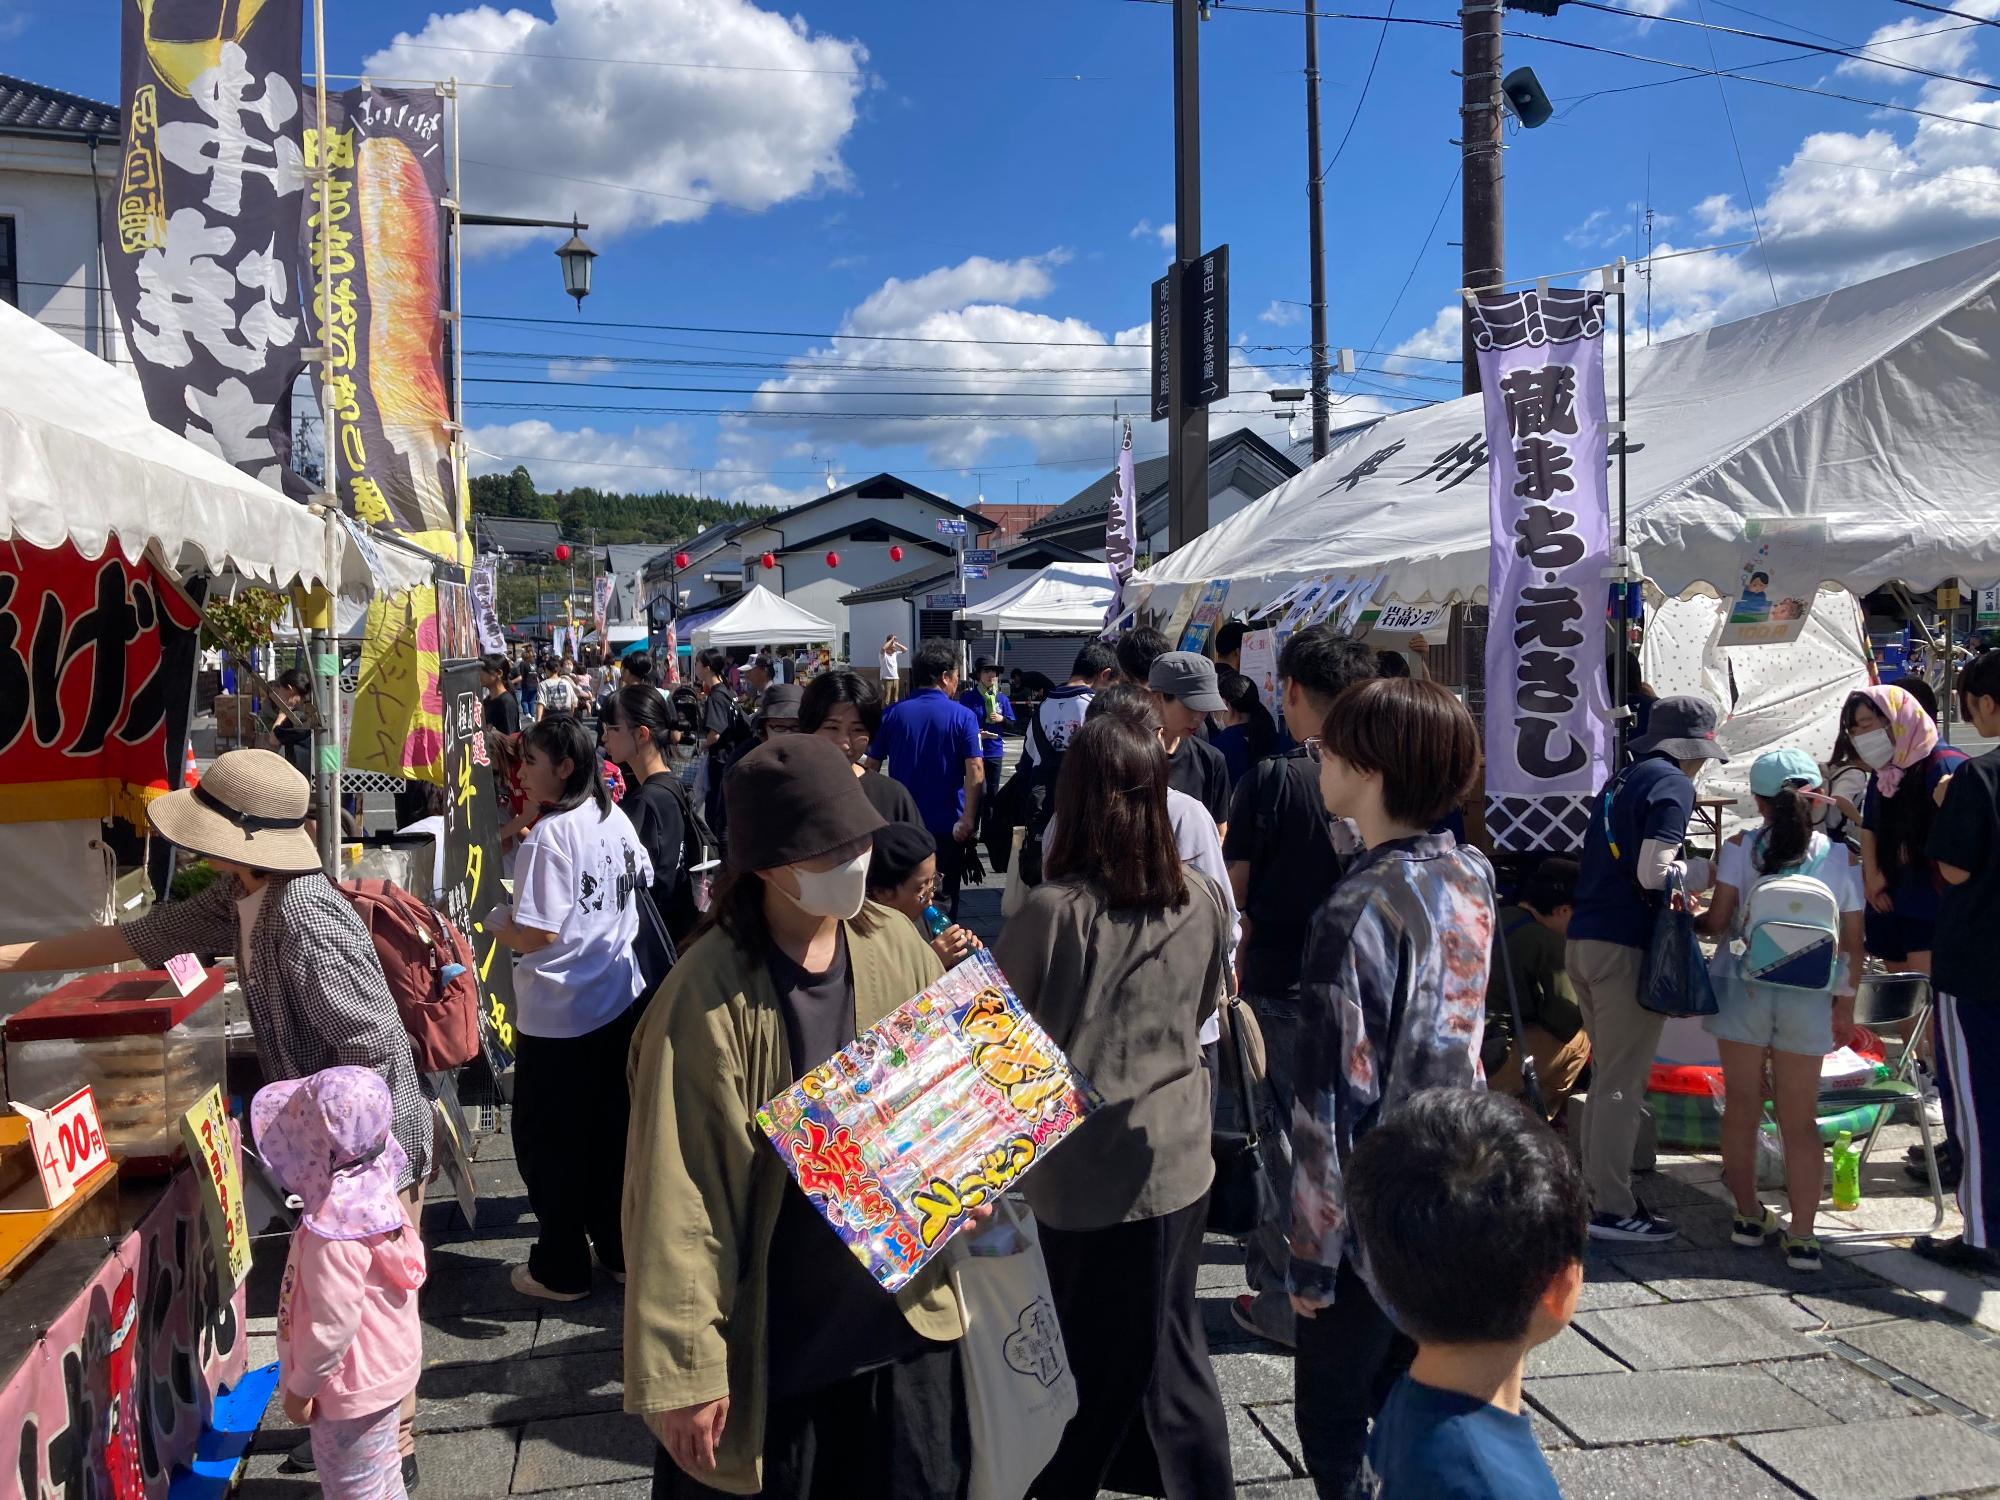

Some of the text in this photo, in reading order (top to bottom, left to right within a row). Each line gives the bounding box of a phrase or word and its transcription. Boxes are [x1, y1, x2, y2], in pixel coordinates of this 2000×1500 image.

[1203, 256, 1215, 379] 菊田一夫記念館
[1501, 364, 1588, 779] 蔵まち・えさし
[43, 1112, 103, 1188] 400円
[882, 1224, 923, 1264] No.1
